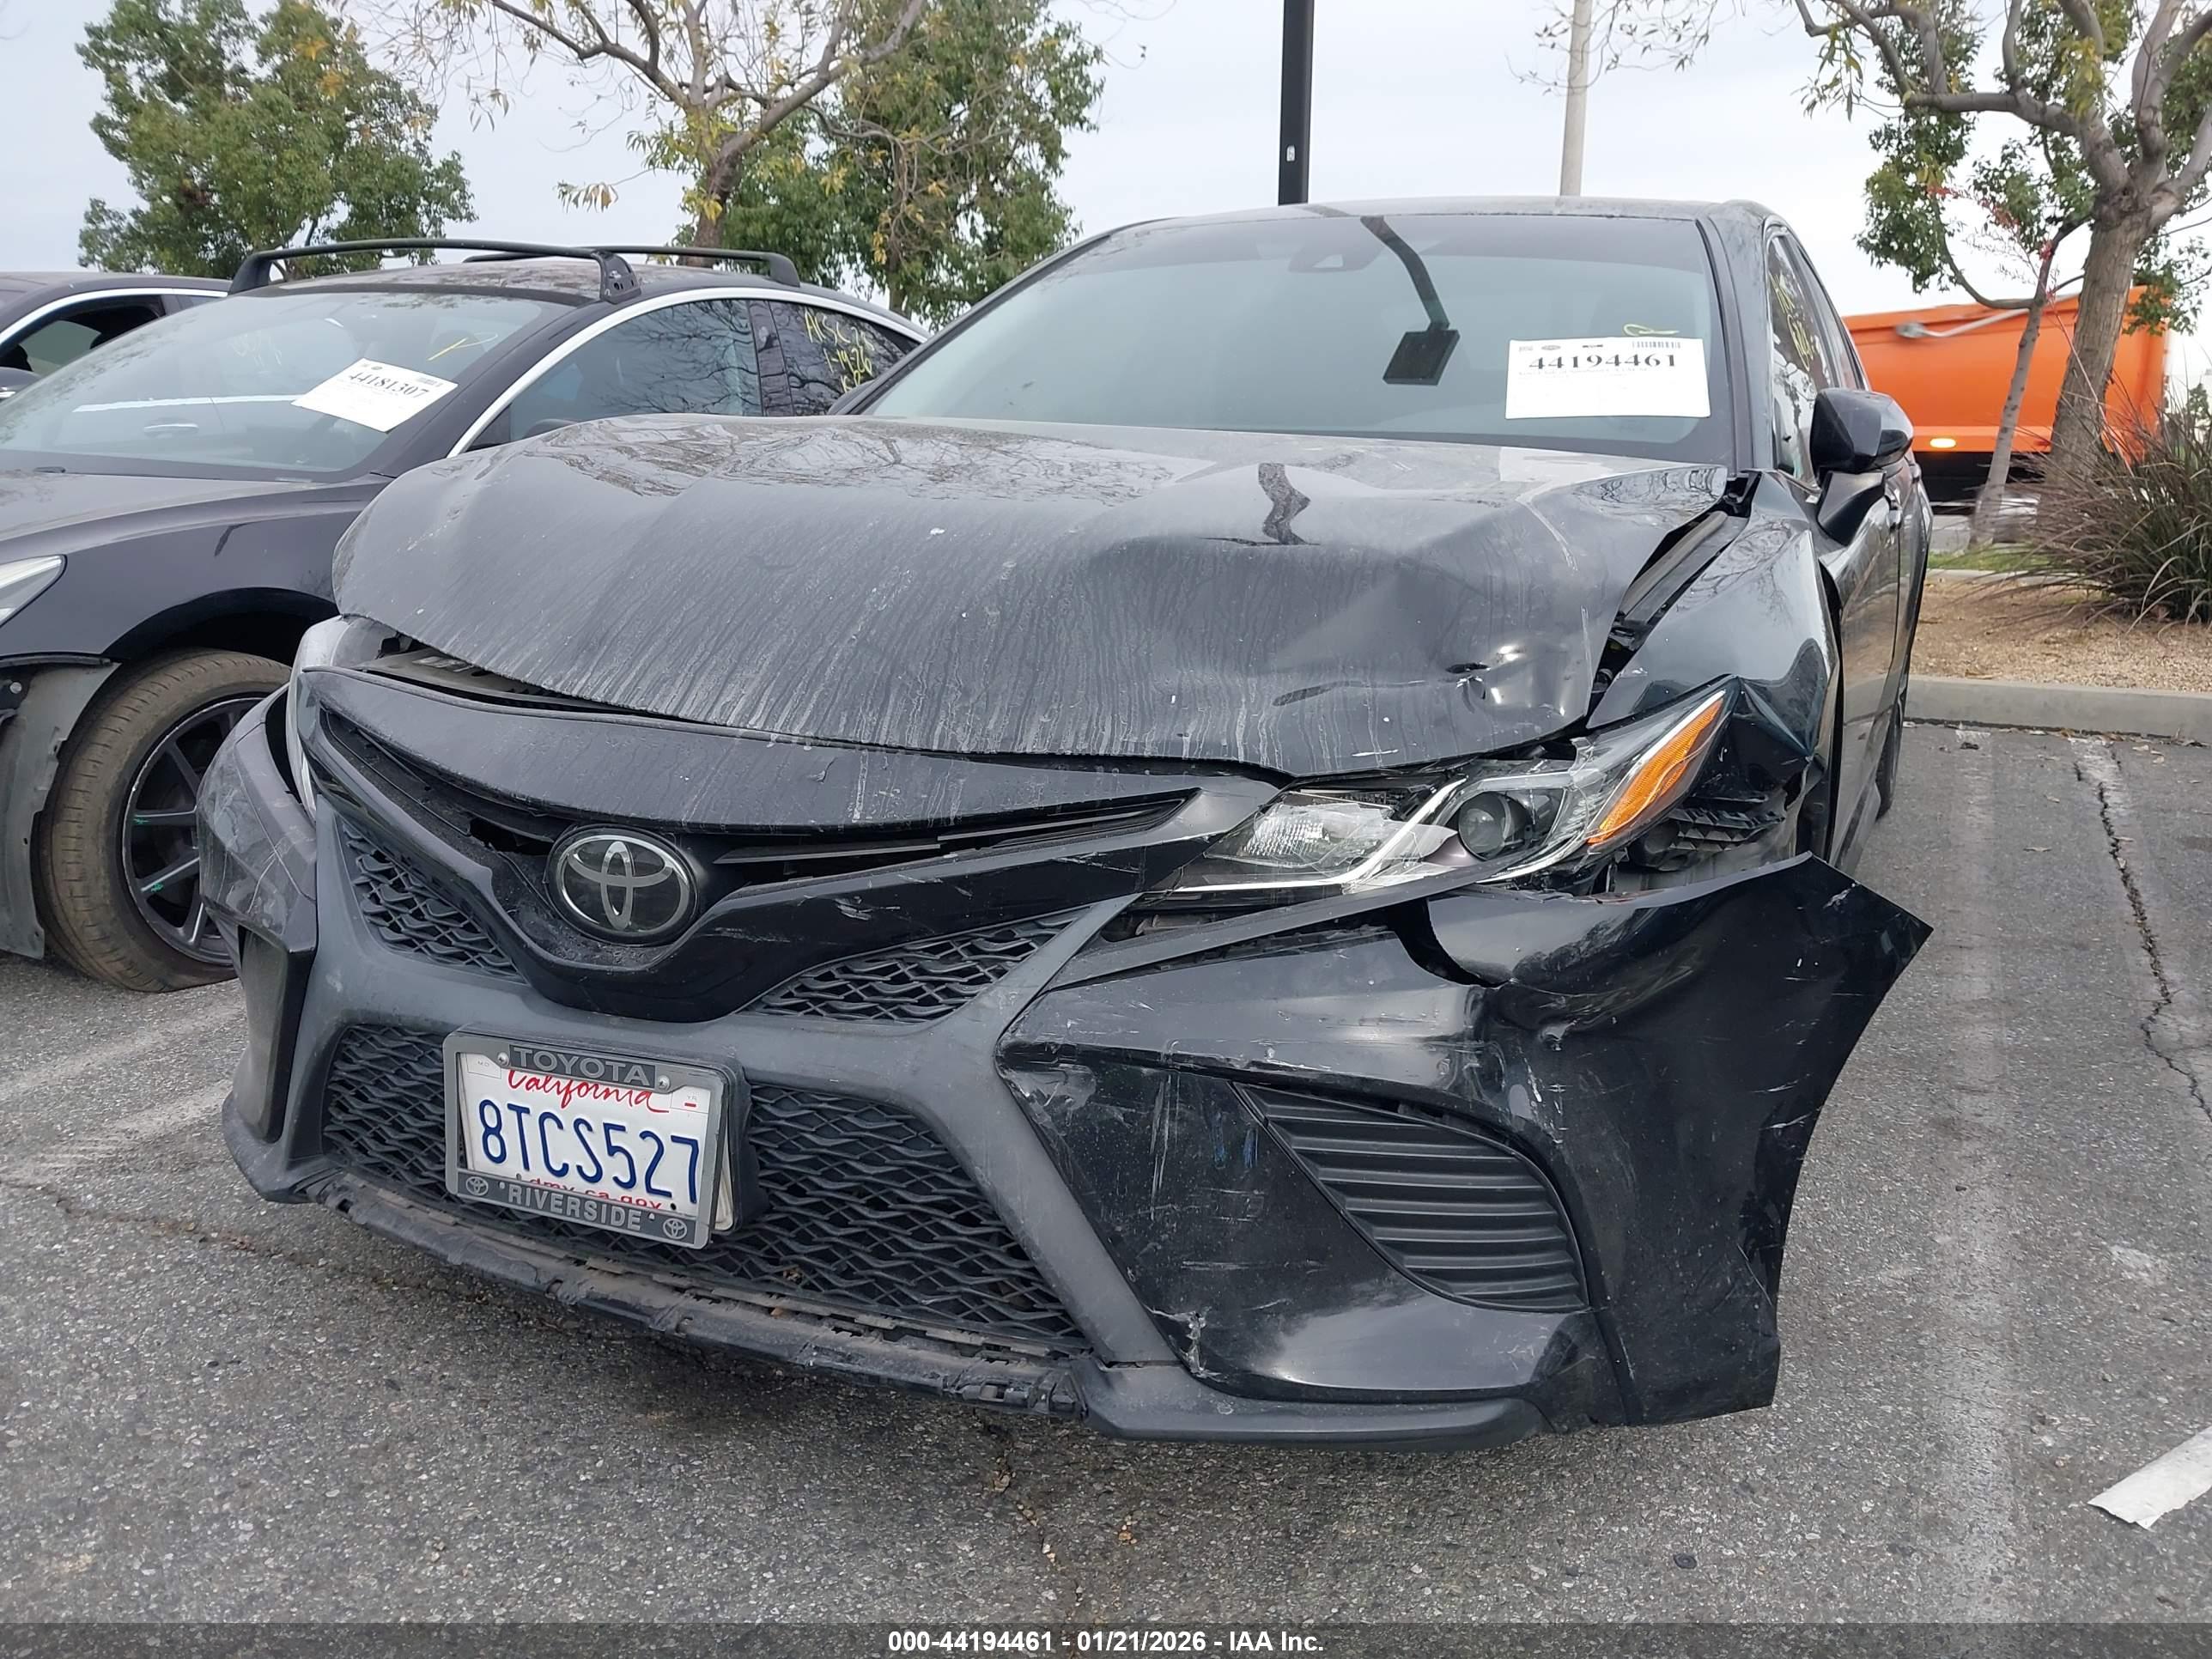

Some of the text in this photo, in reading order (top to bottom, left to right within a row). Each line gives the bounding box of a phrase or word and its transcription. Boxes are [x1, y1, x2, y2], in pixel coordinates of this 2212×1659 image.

[1529, 353, 1675, 369] 44194461
[349, 371, 429, 398] 44181307
[513, 1048, 651, 1087] TOYOTA
[507, 1070, 670, 1113] California
[478, 1098, 700, 1204] 8TCS527
[507, 1184, 643, 1231] RIVERSIDE
